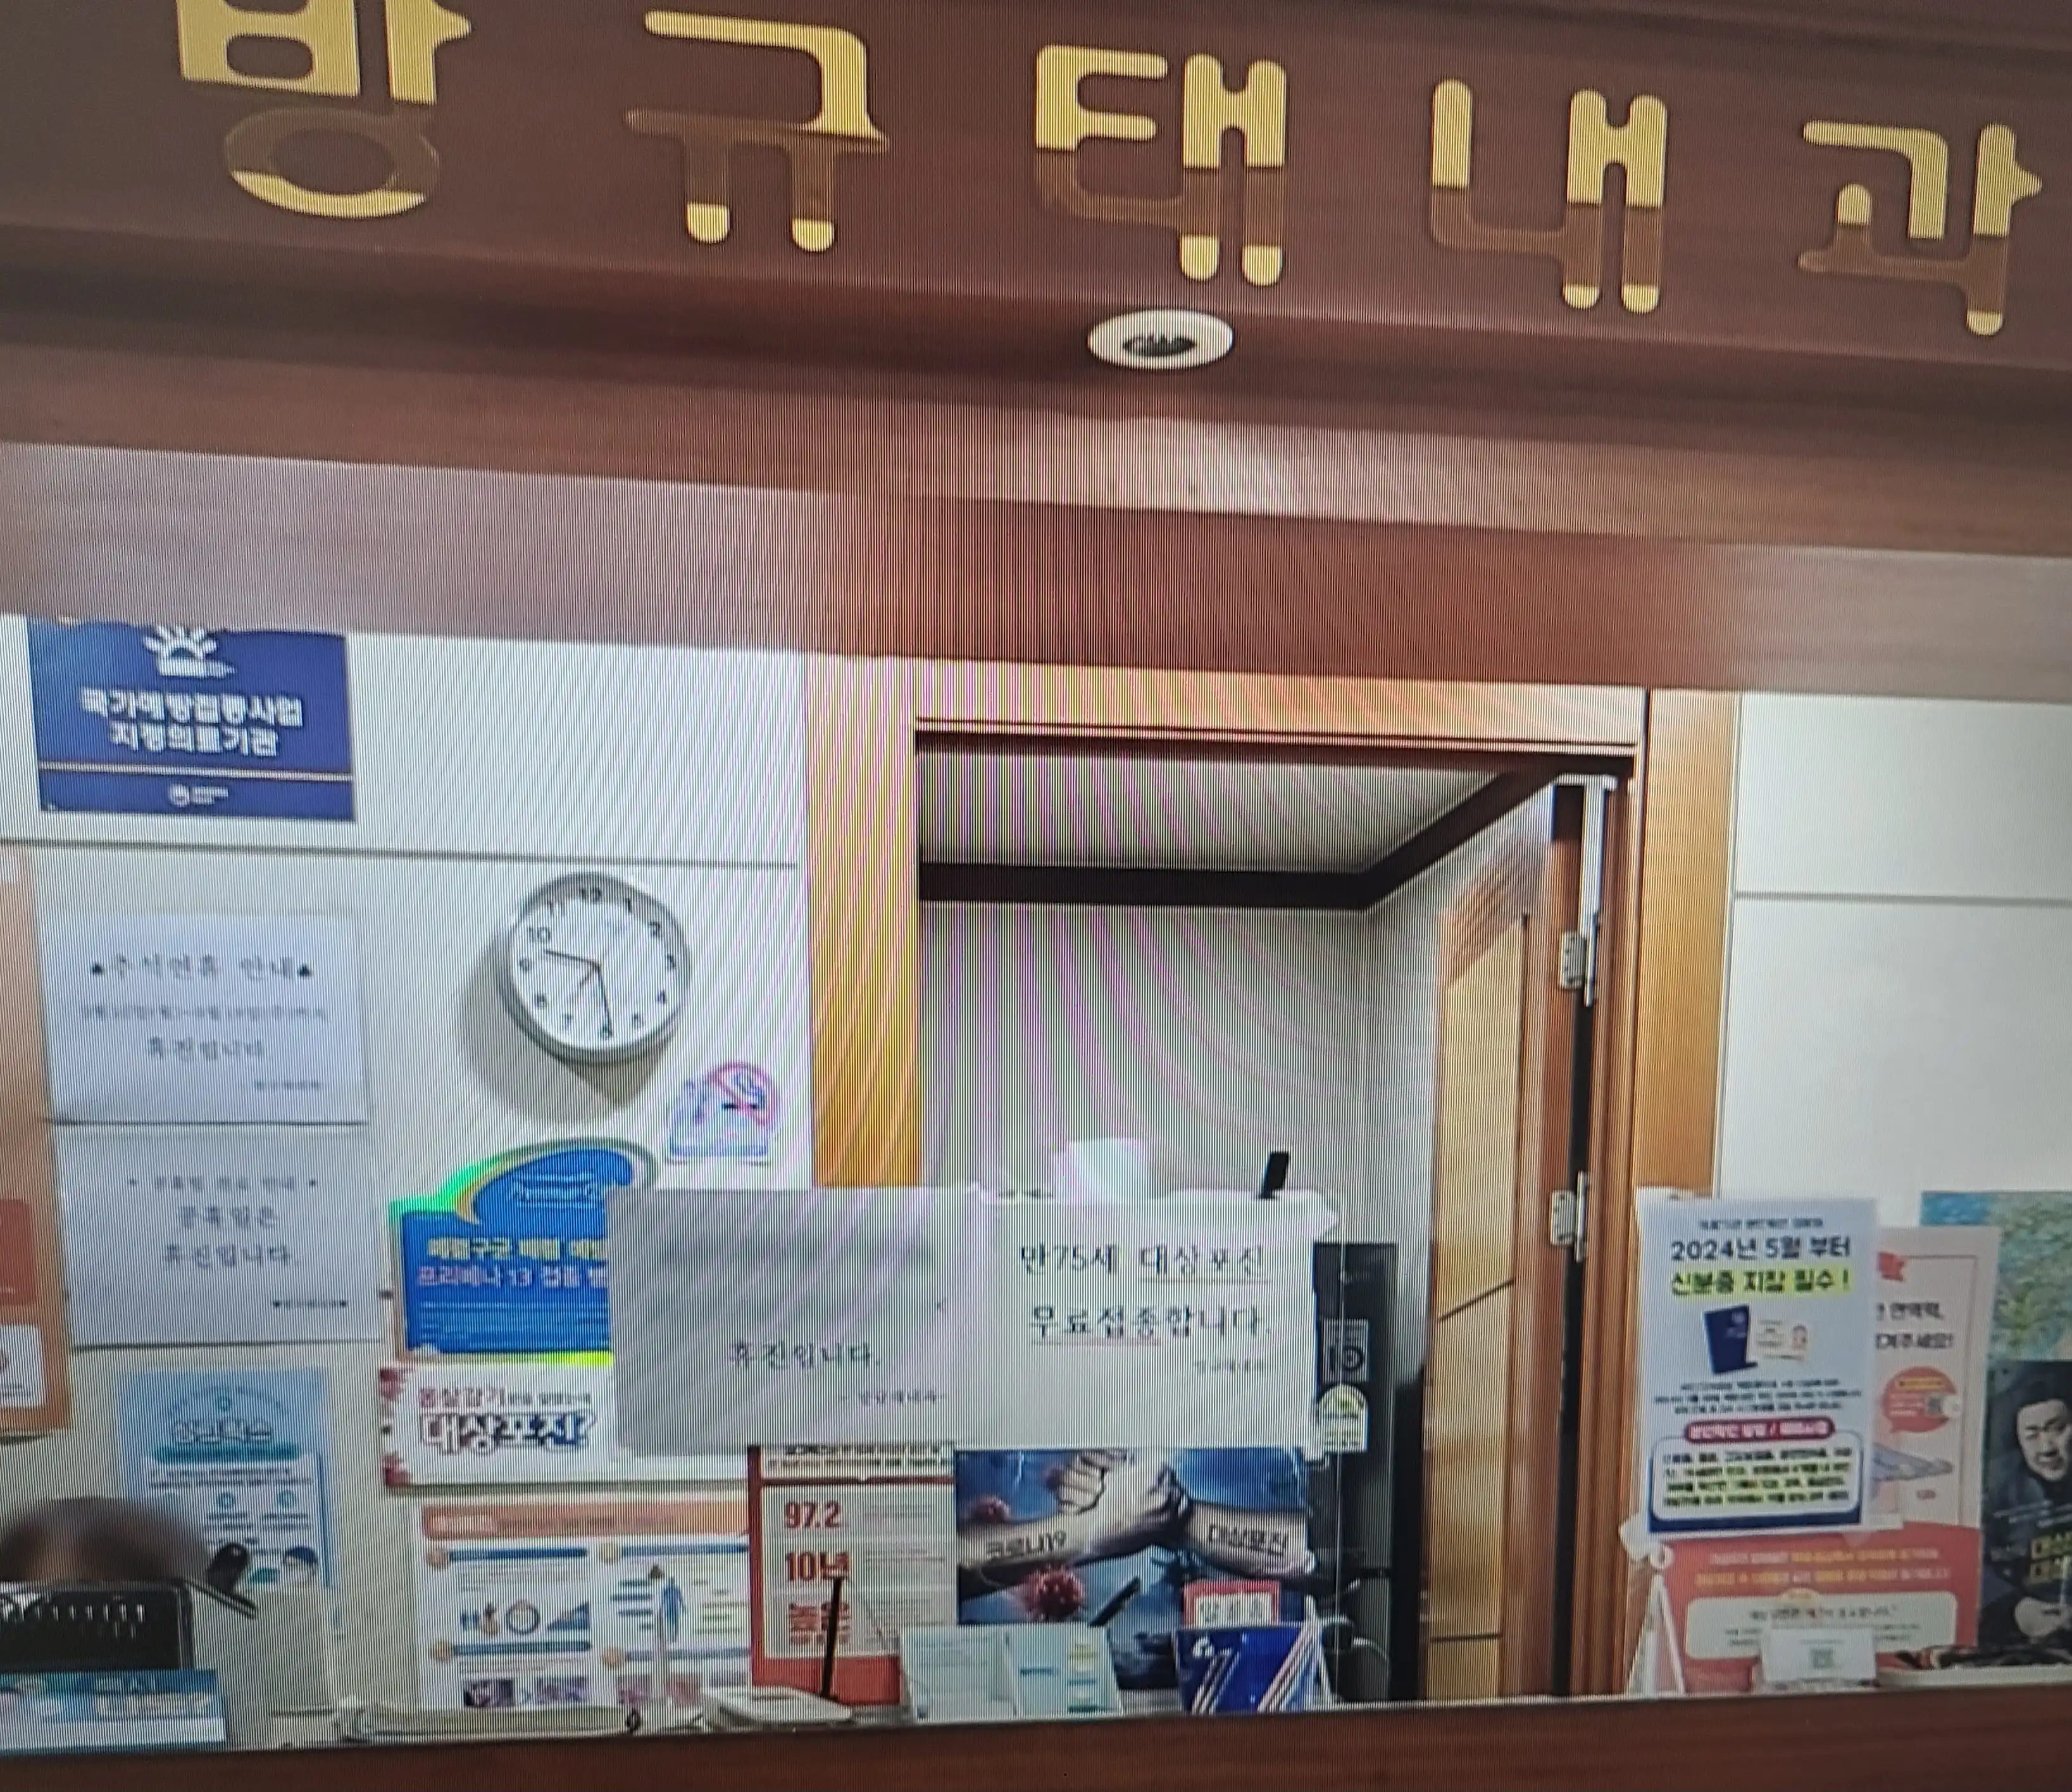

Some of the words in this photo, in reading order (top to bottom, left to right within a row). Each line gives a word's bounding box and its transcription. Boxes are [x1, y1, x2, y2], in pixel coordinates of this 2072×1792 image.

[527, 926, 551, 943] 10
[1018, 1244, 1118, 1275] 만75세
[1139, 1244, 1265, 1276] 대상포진
[1670, 1239, 1757, 1261] 2024년
[1765, 1237, 1801, 1259] 5월
[1810, 1236, 1851, 1258] 부터
[1794, 1270, 1835, 1292] 필수
[1029, 1306, 1271, 1339] 무료접종합니다.
[729, 1341, 883, 1369] 휴진입니다.
[419, 1412, 596, 1454] 대상포진?
[784, 1501, 841, 1529] 97.2
[985, 1529, 1068, 1558] 코로나19
[1208, 1524, 1290, 1557] 대상포진
[785, 1551, 849, 1581] 10년
